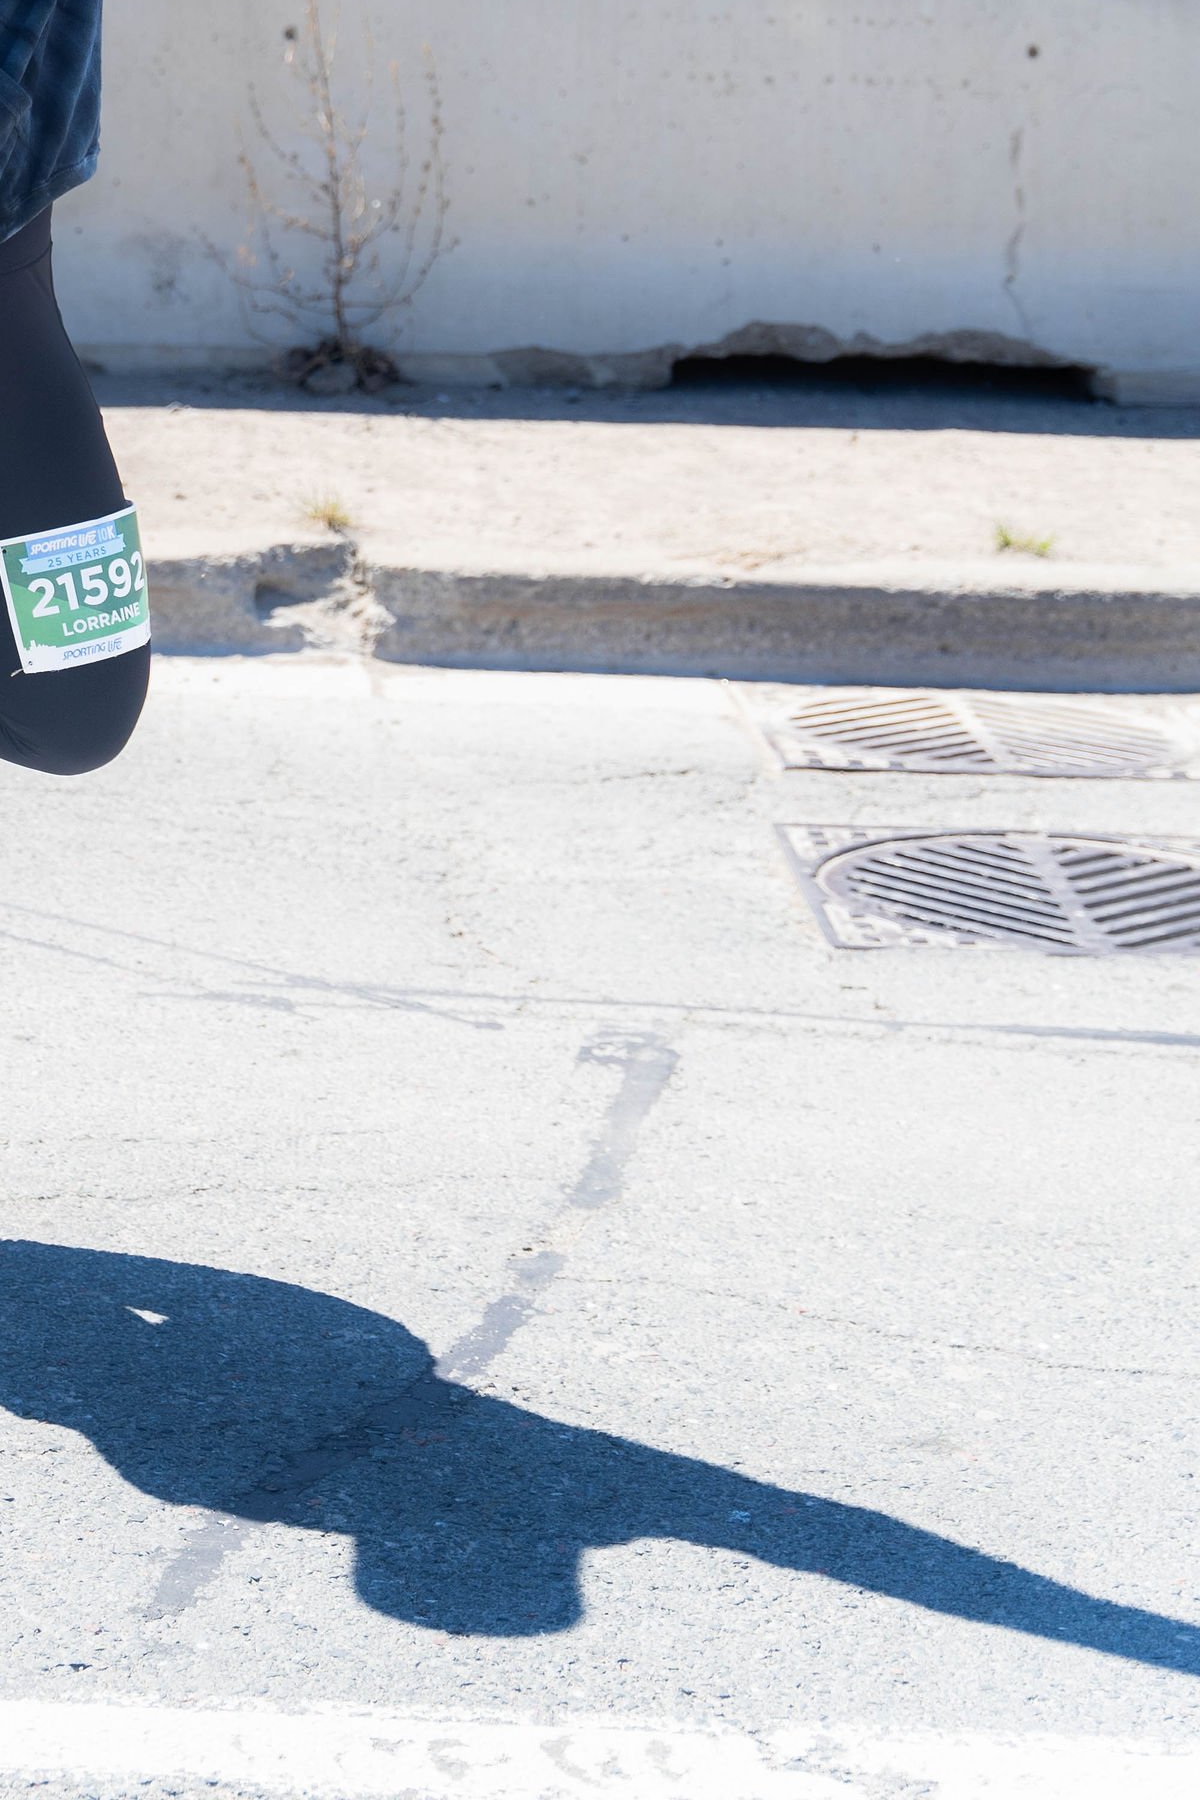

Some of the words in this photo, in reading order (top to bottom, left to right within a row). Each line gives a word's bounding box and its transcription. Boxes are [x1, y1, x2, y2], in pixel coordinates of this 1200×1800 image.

[98, 525, 116, 542] 10K
[48, 557, 62, 568] 25
[67, 545, 107, 563] YEARS
[27, 551, 145, 618] 21592
[62, 601, 141, 637] LORRAINE
